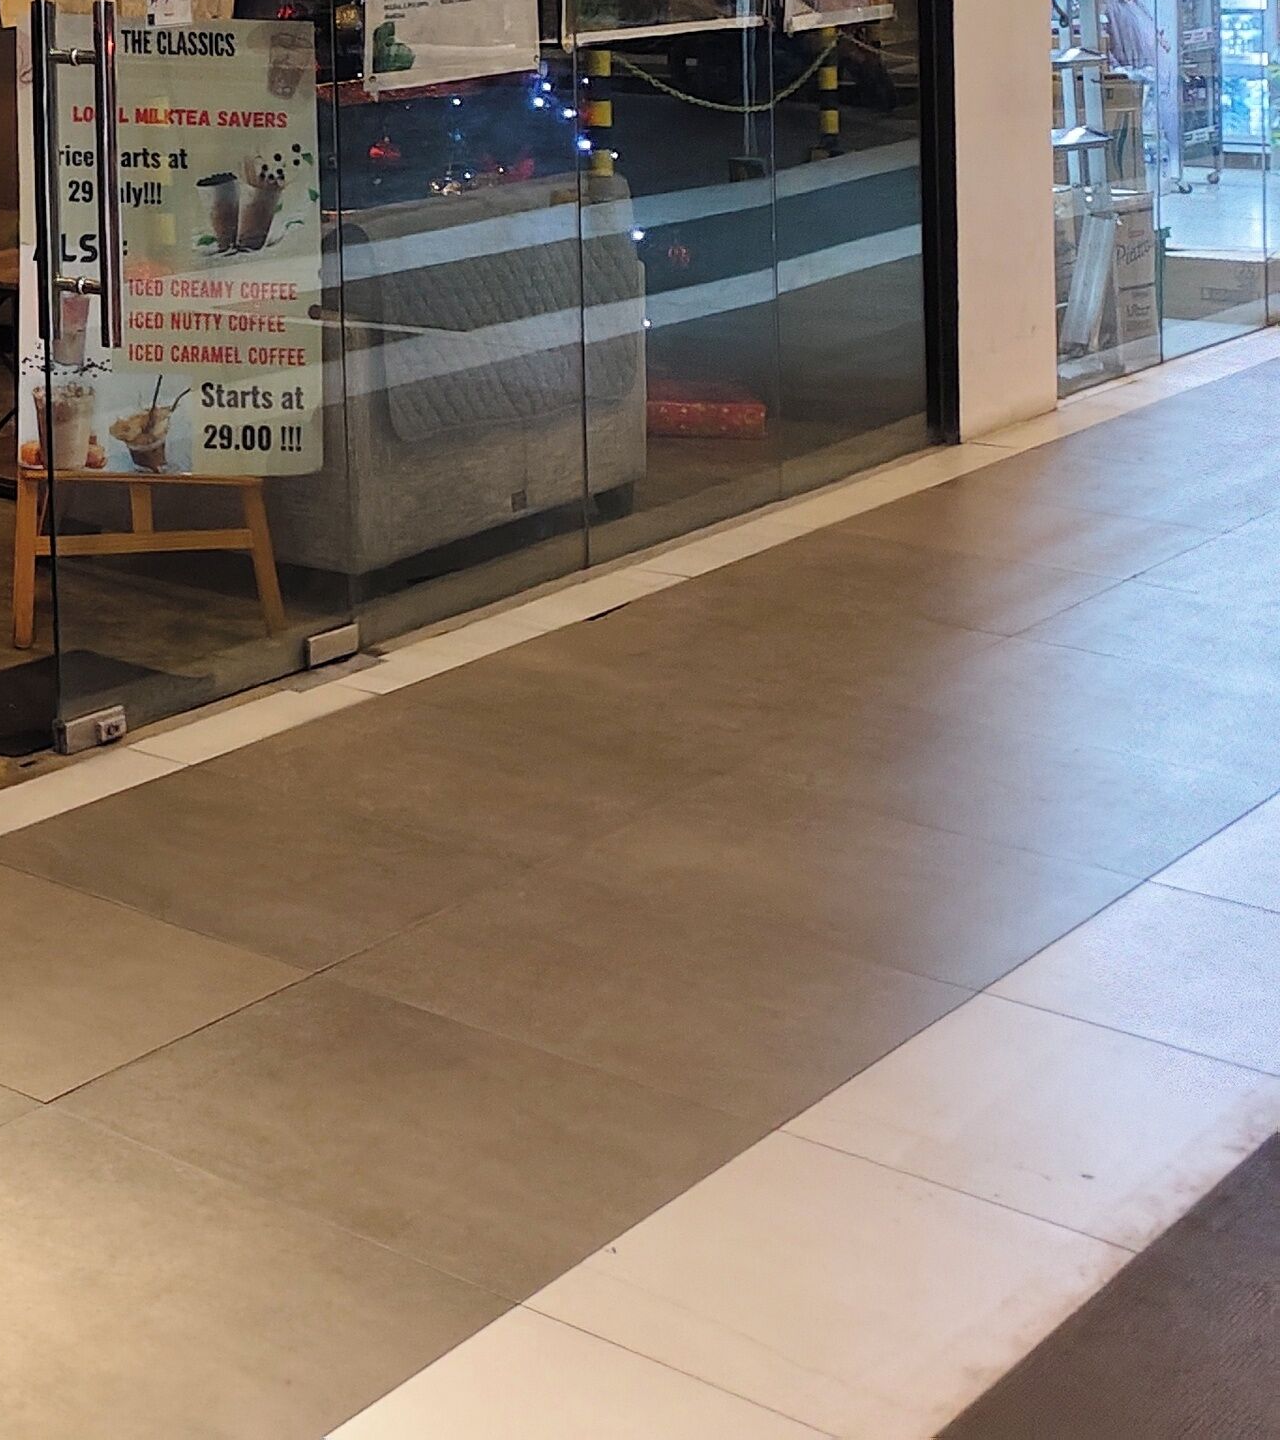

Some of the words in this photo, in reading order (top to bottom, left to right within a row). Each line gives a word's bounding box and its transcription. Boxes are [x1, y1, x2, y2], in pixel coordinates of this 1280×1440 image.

[120, 29, 152, 54] THE
[157, 31, 236, 57] CLASSICS
[72, 106, 129, 124] LOL
[135, 107, 211, 126] MILKTEA
[217, 110, 288, 128] SAVERS
[57, 144, 94, 167] rice
[120, 147, 162, 169] arts
[168, 148, 189, 169] at
[68, 180, 94, 203] 29
[128, 279, 163, 297] ICED
[171, 279, 234, 299] CREAMY
[240, 282, 298, 300] COFFEE
[128, 312, 163, 330] ICED
[171, 312, 222, 331] NUTTY
[228, 314, 286, 332] COFFEE
[128, 343, 164, 361] ICED
[171, 345, 242, 364] CARAMEL
[248, 347, 306, 366] COFFEE
[201, 382, 273, 409] Starts
[281, 386, 305, 410] at
[203, 424, 272, 451] 29.00
